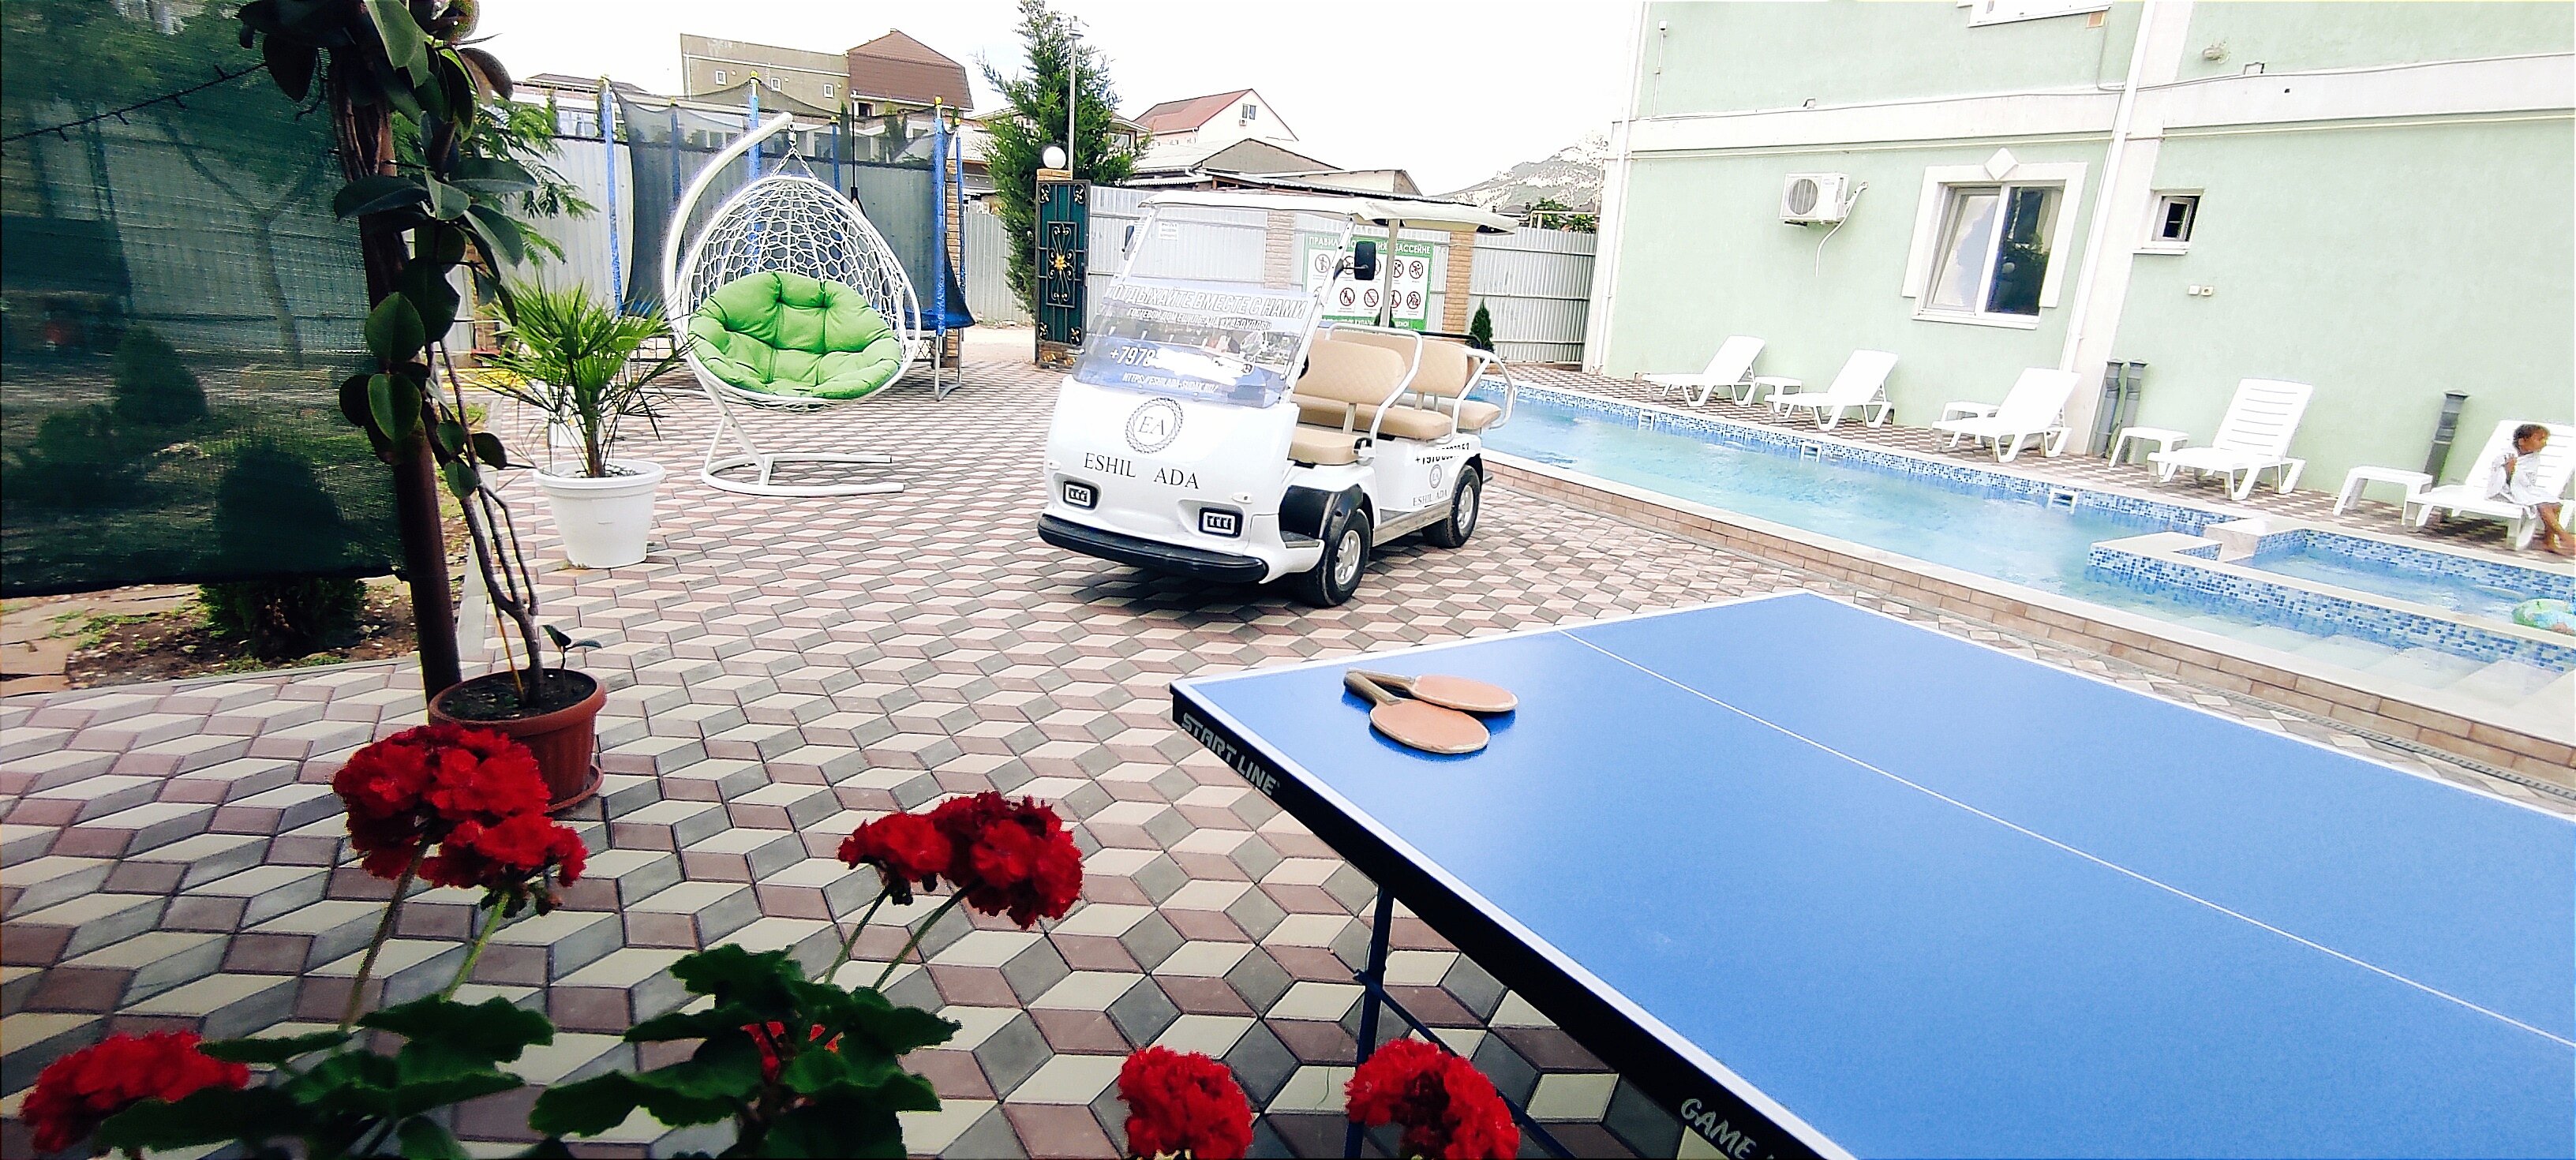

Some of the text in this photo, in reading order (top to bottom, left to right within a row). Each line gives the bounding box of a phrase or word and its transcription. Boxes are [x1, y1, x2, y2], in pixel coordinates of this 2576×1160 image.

[1309, 236, 1339, 247] ПРАВИЛ
[1111, 283, 1309, 320] ОТДЫХАЙТЕ ВМЕСТЕ С НАМИ
[1139, 416, 1165, 436] EA
[1084, 451, 1200, 489] ESHIL ADA
[1181, 713, 1277, 796] START LINE
[1680, 1098, 1757, 1159] GAME
